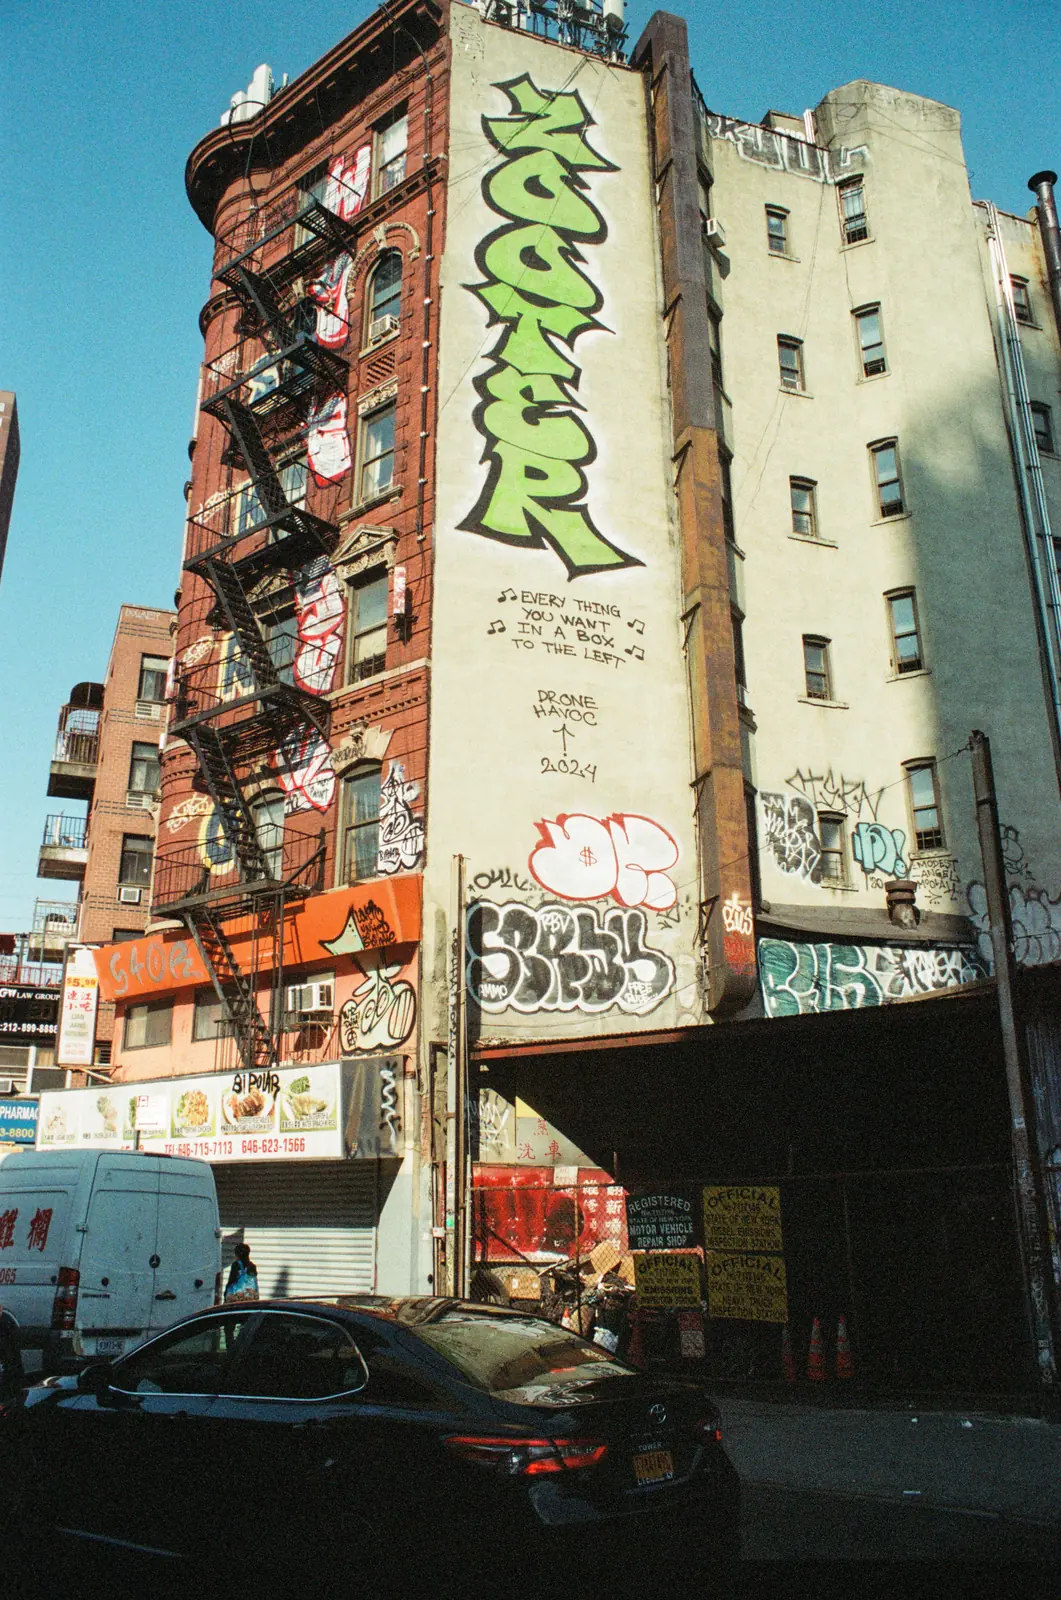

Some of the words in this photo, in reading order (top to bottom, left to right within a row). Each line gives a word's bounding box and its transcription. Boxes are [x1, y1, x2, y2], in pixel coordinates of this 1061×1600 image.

[521, 590, 566, 608] EVERY
[573, 599, 621, 618] THING
[521, 607, 554, 621] YOU
[561, 614, 610, 632] WANT
[517, 622, 542, 635] IN
[554, 626, 566, 640] A
[577, 629, 614, 648] BOX
[512, 638, 534, 649] TO
[542, 641, 577, 656] THE
[584, 647, 626, 669] LEFT
[538, 689, 599, 710] DRONE
[533, 704, 597, 726] HAVOC
[540, 757, 597, 783] 2024
[67, 978, 96, 988] $5.99
[35, 993, 60, 1001] GROUP
[241, 1137, 306, 1153] 646-623-1566
[628, 1195, 691, 1214] REGISTERED
[708, 1187, 778, 1210] OFFICIAL
[629, 1224, 657, 1235] MOTOR
[660, 1222, 695, 1235] VEHICLE
[637, 1235, 664, 1247] REPAIR
[666, 1235, 688, 1247] SHOP
[638, 1255, 694, 1275] OFFICIAL
[712, 1256, 782, 1282] OFFICIAL
